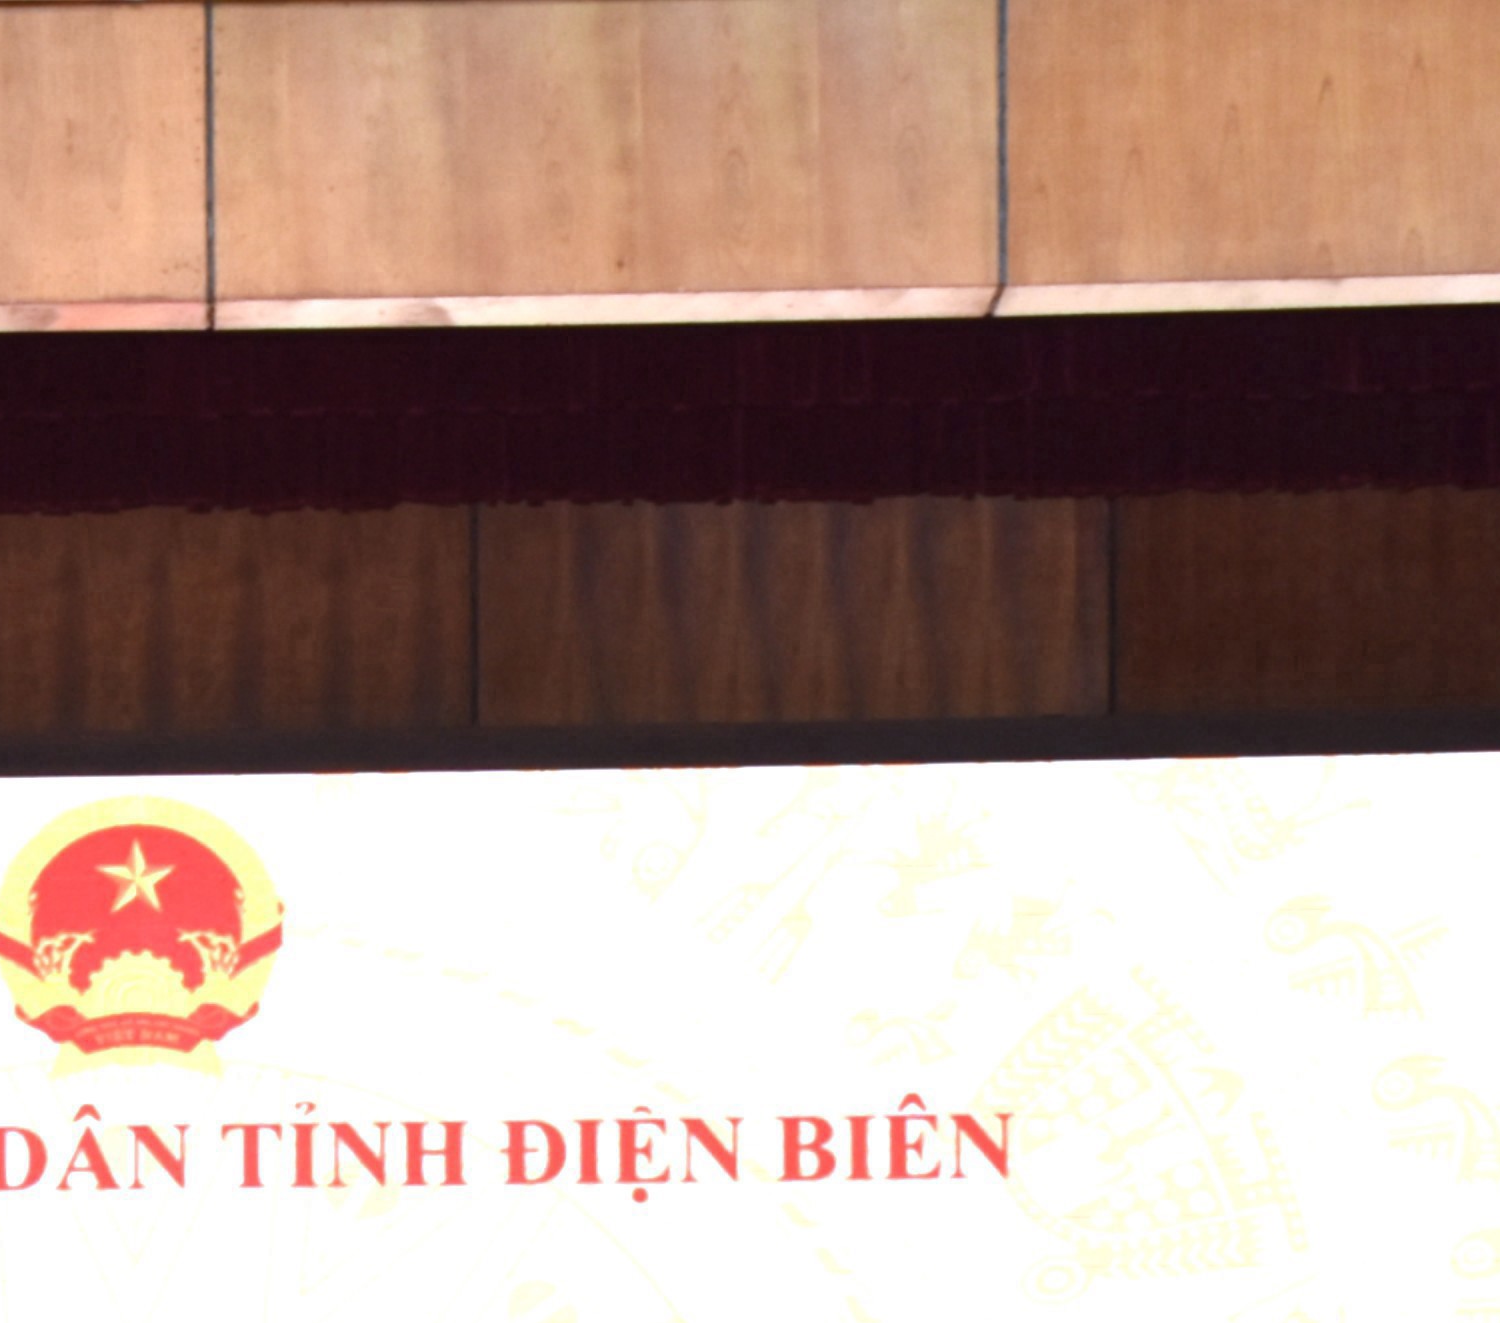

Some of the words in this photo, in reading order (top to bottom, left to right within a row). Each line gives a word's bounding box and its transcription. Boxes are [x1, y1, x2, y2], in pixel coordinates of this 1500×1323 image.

[221, 1103, 465, 1188] TỈNH
[502, 1106, 741, 1203] ĐIỆN
[779, 1093, 1012, 1181] BIÊN
